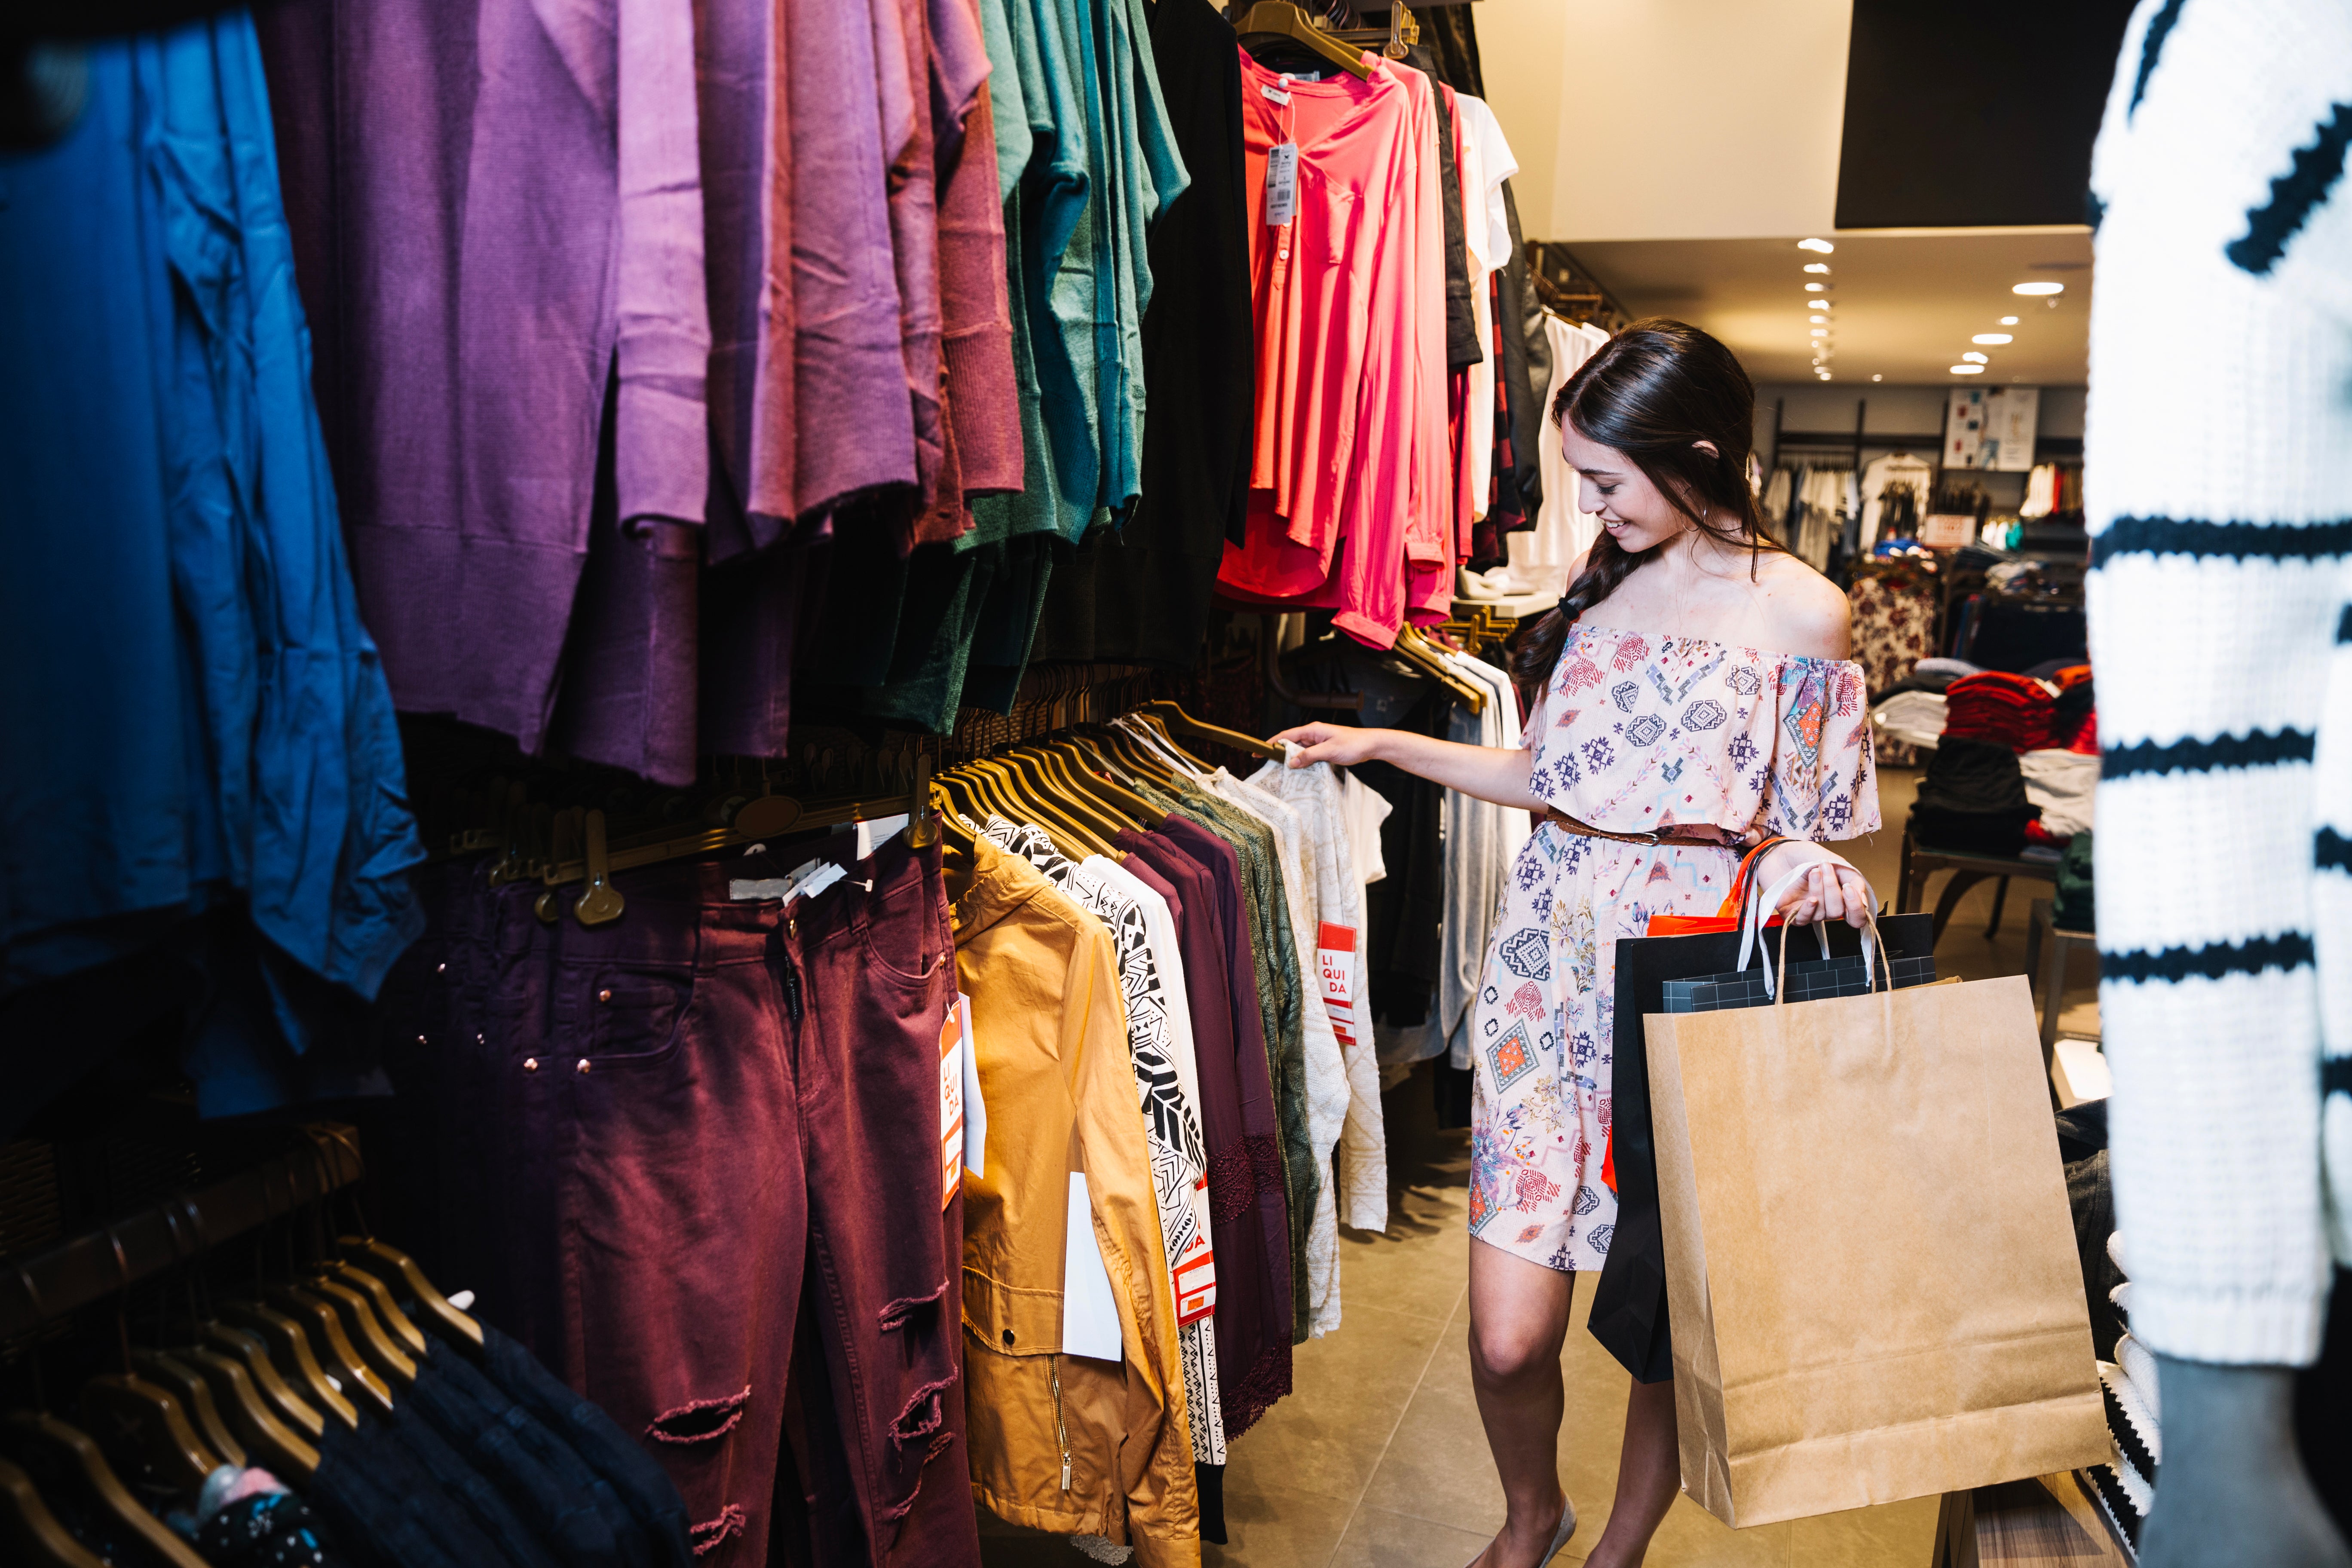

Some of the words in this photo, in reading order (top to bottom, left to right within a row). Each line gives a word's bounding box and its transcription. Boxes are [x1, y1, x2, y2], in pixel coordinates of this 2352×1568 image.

[1323, 955, 1332, 966] LI
[1323, 968, 1344, 980] QUI
[1330, 983, 1346, 993] DA
[944, 1063, 949, 1082] LI
[945, 1073, 957, 1100] QUI
[949, 1094, 959, 1117] DA
